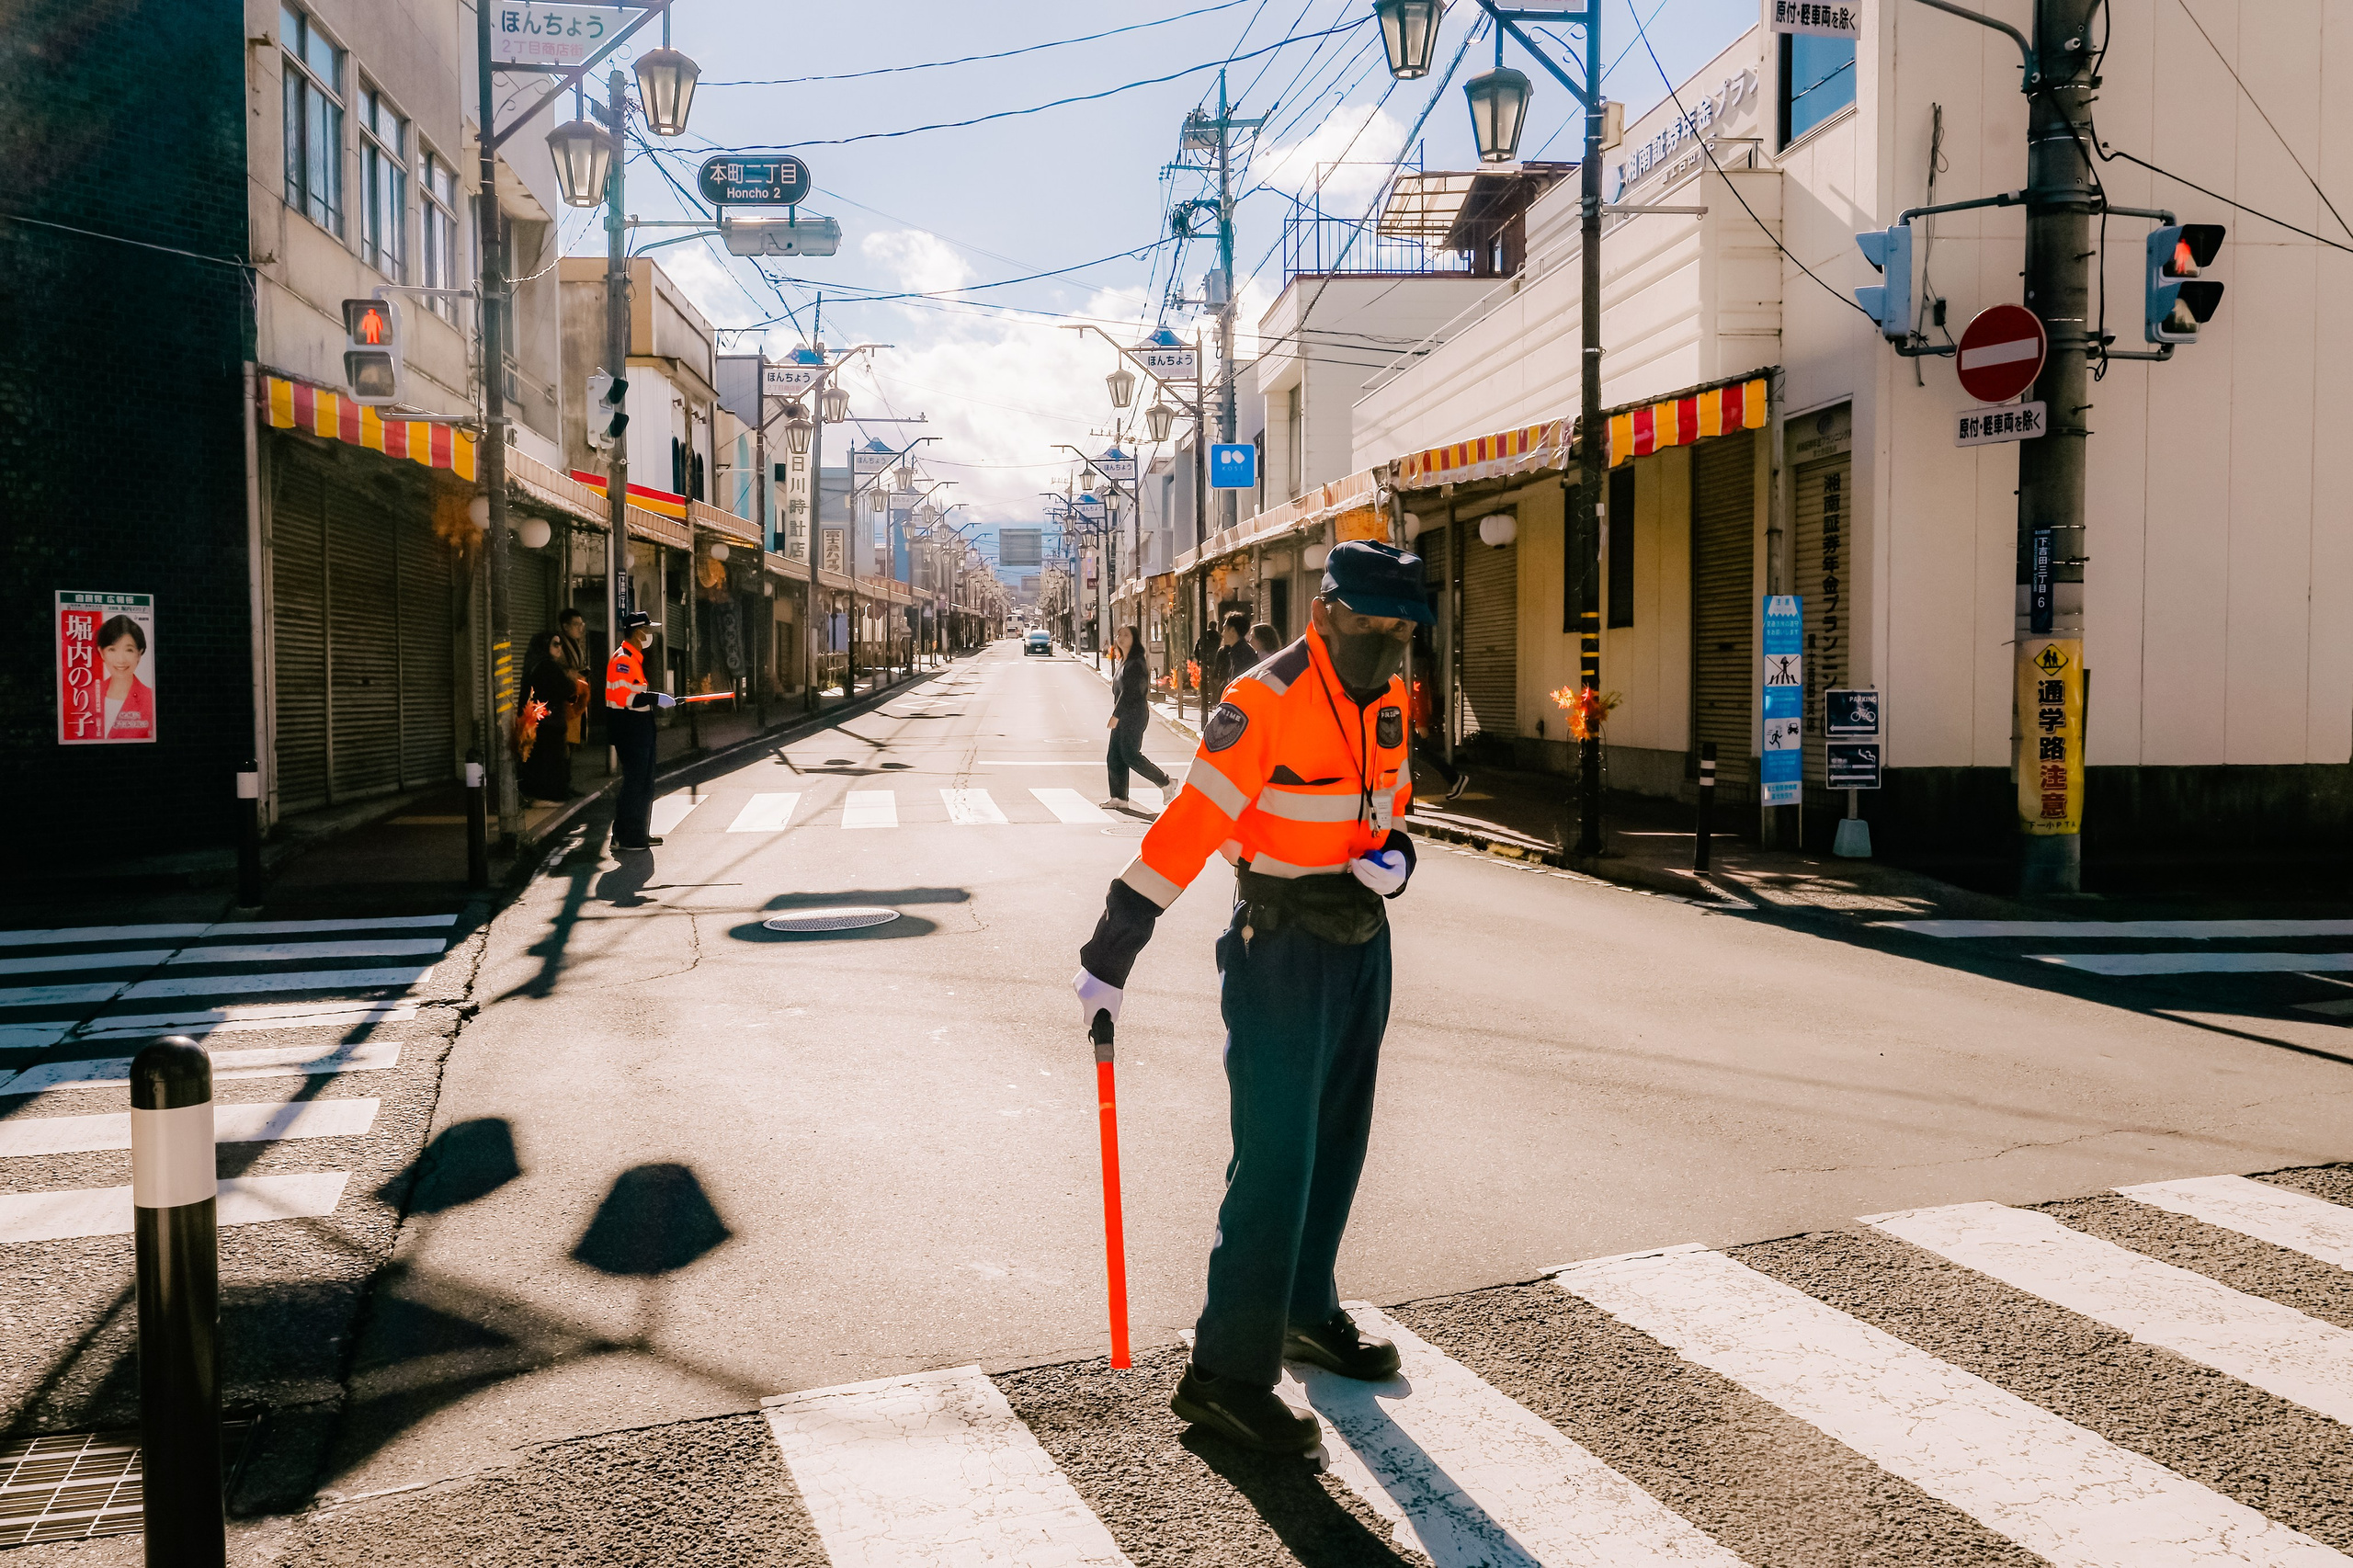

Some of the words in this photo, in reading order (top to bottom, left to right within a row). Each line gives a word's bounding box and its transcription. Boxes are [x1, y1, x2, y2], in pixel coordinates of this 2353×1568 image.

[502, 10, 604, 39] ほんちょう
[1776, 1, 1856, 30] 原付・軽車両を除く
[502, 40, 584, 57] 2丁目商店街
[710, 164, 797, 185] 本町二丁目
[727, 187, 769, 199] Honcho
[773, 187, 781, 199] 2
[1148, 354, 1193, 367] ほんちょう
[767, 371, 811, 383] ほんちょう
[1960, 410, 2040, 439] 原付・軽車両を除く
[1104, 463, 1132, 472] ほんちょう
[789, 456, 807, 558] 日川時計店
[2037, 597, 2046, 608] 6
[64, 614, 95, 737] 堀内のり子
[1381, 710, 1400, 719] PRI
[2038, 679, 2068, 819] 通学路注意
